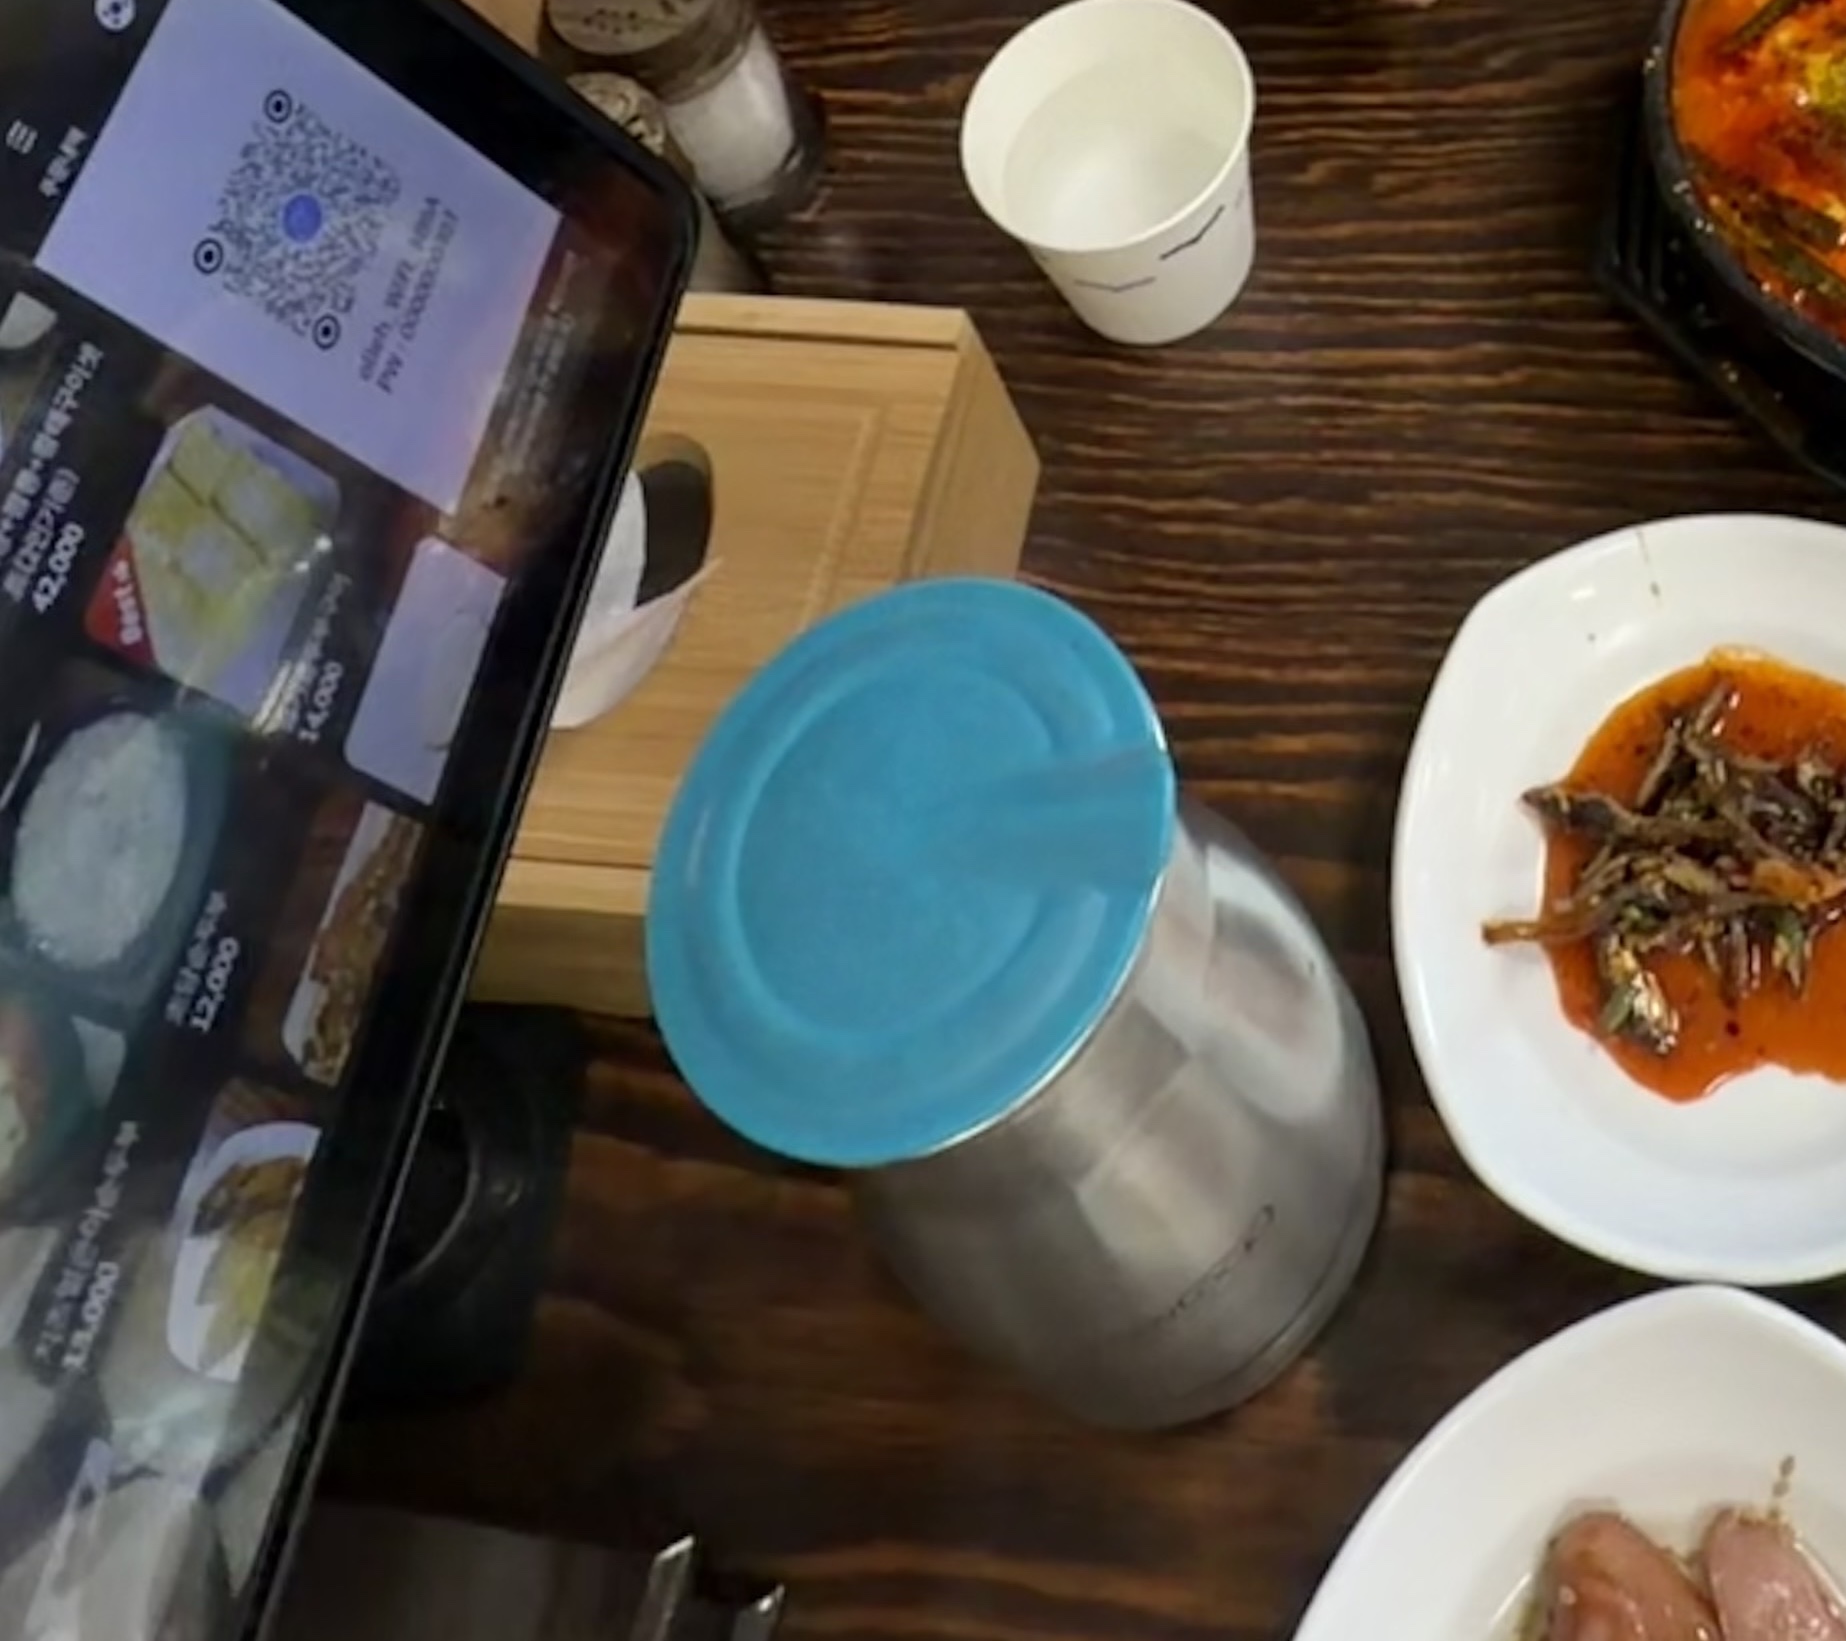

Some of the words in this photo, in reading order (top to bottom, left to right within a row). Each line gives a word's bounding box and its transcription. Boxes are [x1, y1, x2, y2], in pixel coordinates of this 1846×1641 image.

[32, 522, 84, 613] 42,000
[298, 661, 344, 743] 14,000
[190, 936, 240, 1034] 12,000
